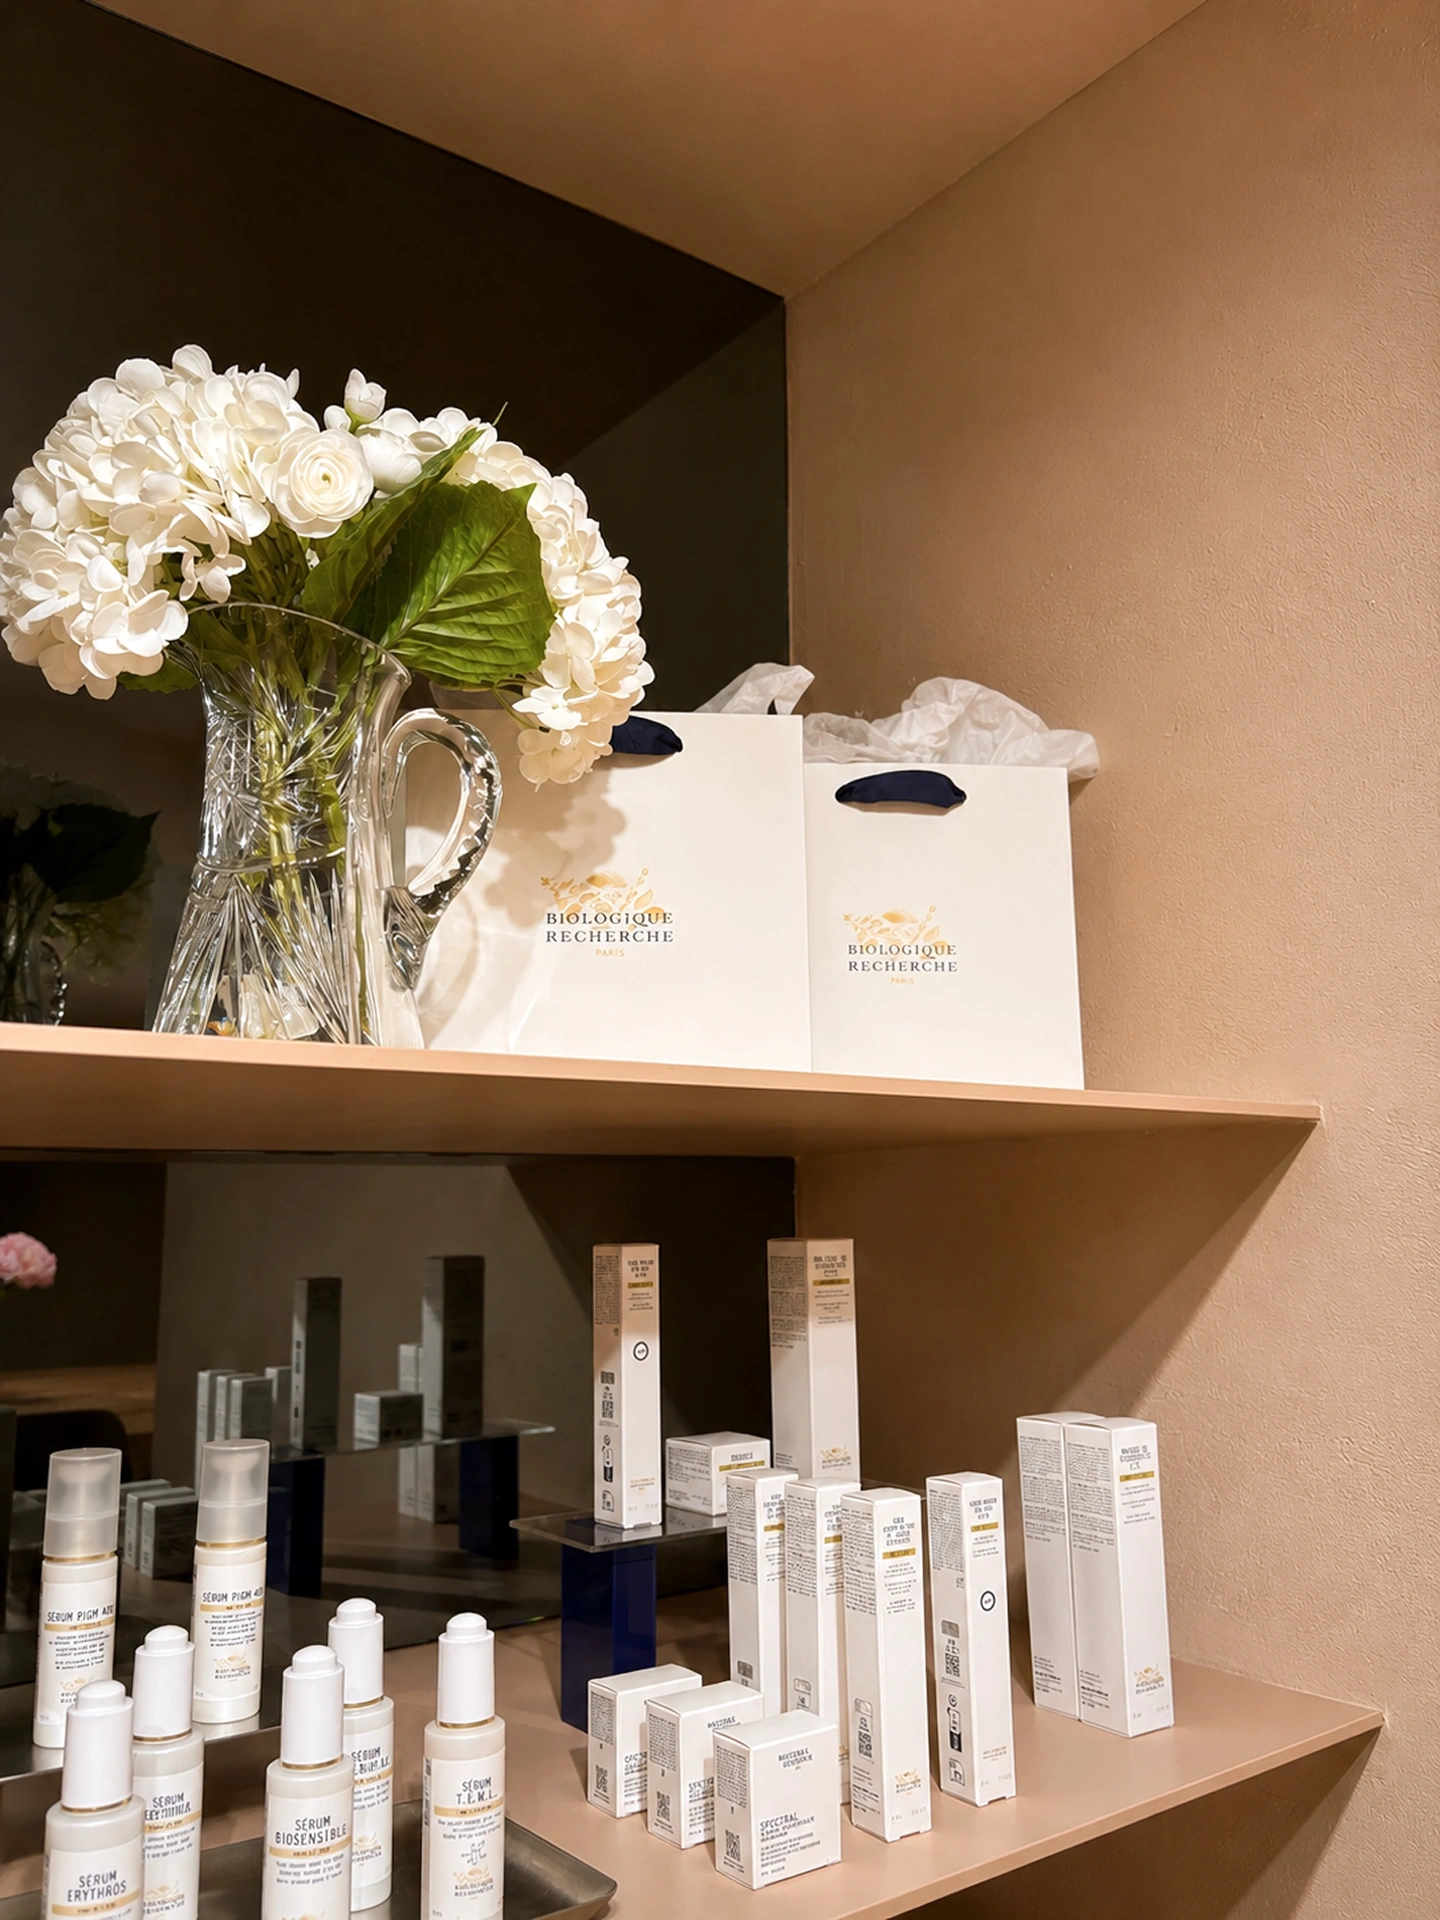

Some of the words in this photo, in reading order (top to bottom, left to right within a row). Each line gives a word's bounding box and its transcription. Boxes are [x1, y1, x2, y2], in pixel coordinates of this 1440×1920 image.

[546, 911, 674, 927] BIOLOGIQUE
[546, 930, 674, 943] RECHERCHE
[595, 948, 625, 957] PARIS
[848, 944, 957, 959] BIOLOGIQUE
[848, 961, 958, 972] RECHERCHE
[275, 1823, 347, 1846] BIOSENSIBLE
[67, 1879, 127, 1902] ERYTHROS
